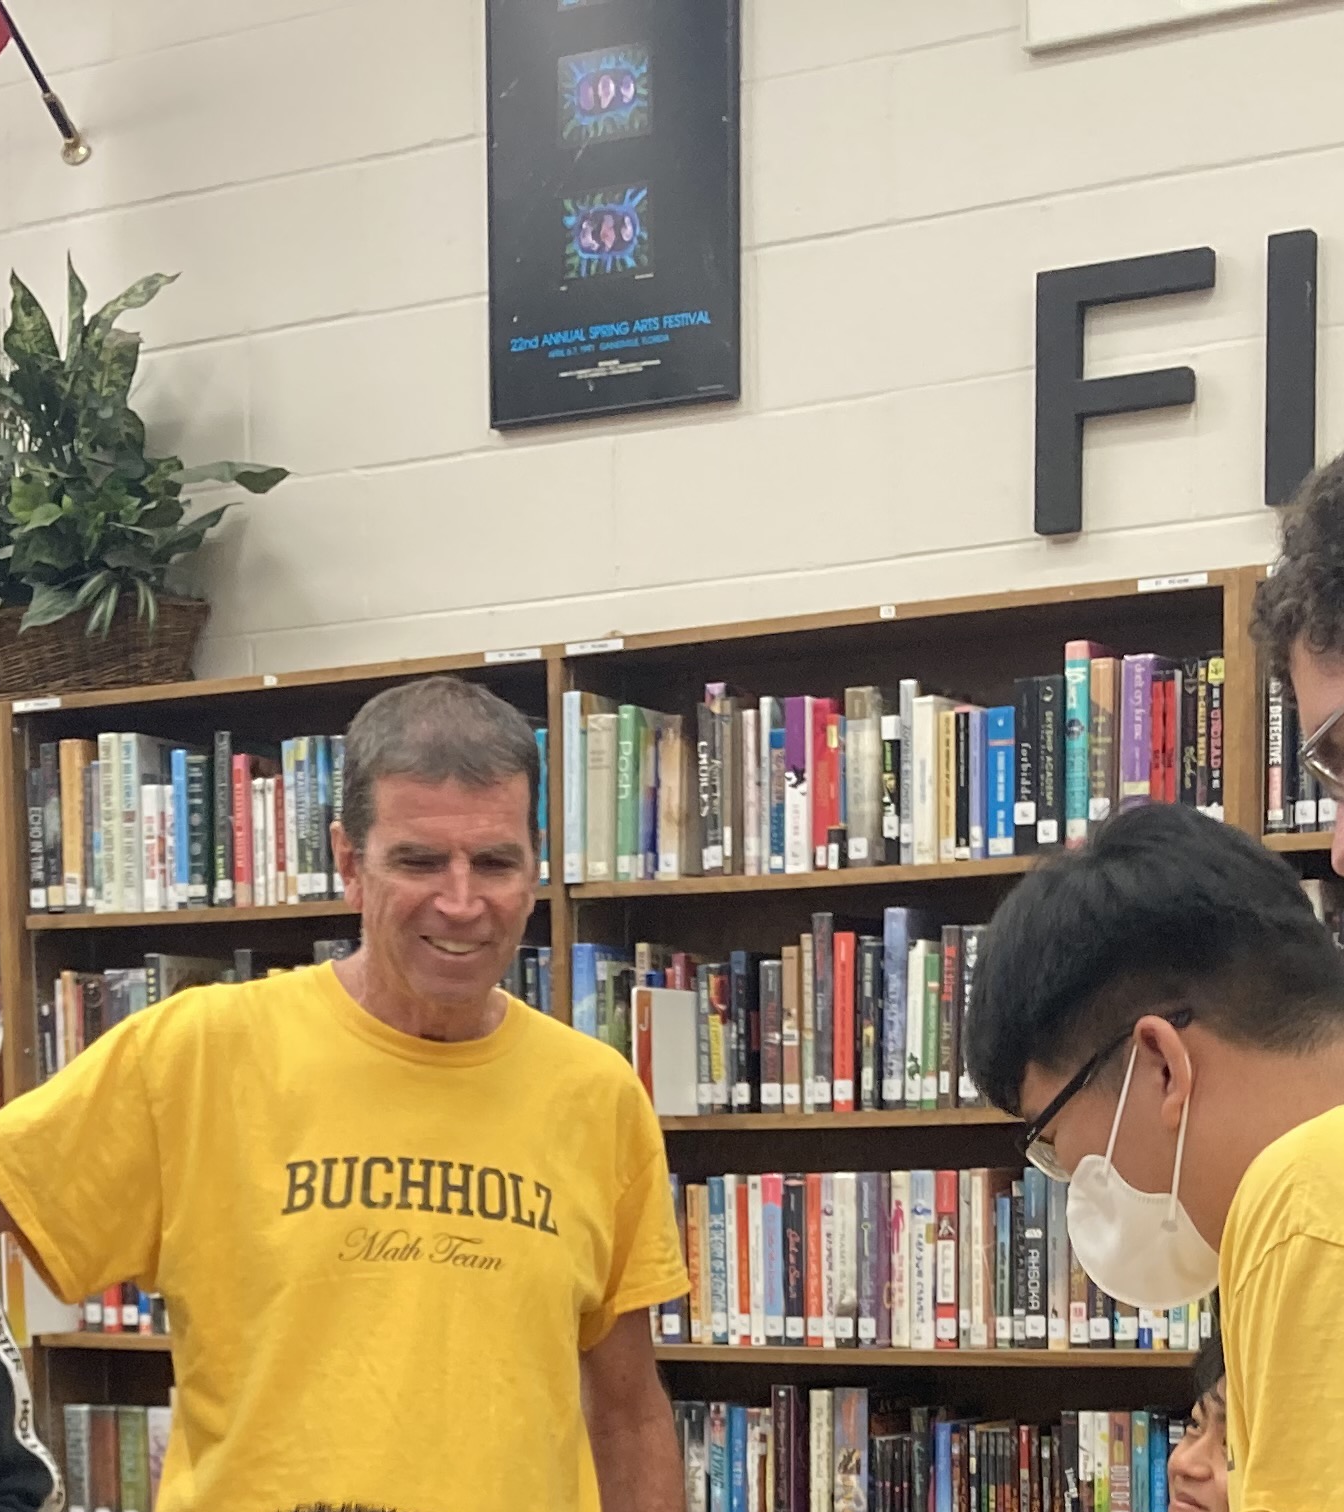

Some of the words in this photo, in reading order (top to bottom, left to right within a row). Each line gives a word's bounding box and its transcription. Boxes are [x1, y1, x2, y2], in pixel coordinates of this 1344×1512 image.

[541, 329, 586, 347] ANNUAL
[588, 321, 630, 339] SPRING
[632, 316, 660, 333] ARTS
[662, 311, 711, 329] FESTIVAL
[1268, 706, 1282, 764] DETECTIVE
[617, 740, 634, 800] Posh
[1020, 742, 1032, 802] forbidde
[29, 806, 43, 838] ECHO
[30, 855, 44, 882] TIME
[280, 1156, 560, 1238] BUCHHOLZ
[338, 1227, 424, 1264] Math
[429, 1234, 506, 1273] Team
[1028, 1248, 1041, 1310] AHSOKA
[712, 1444, 725, 1488] FLYING
